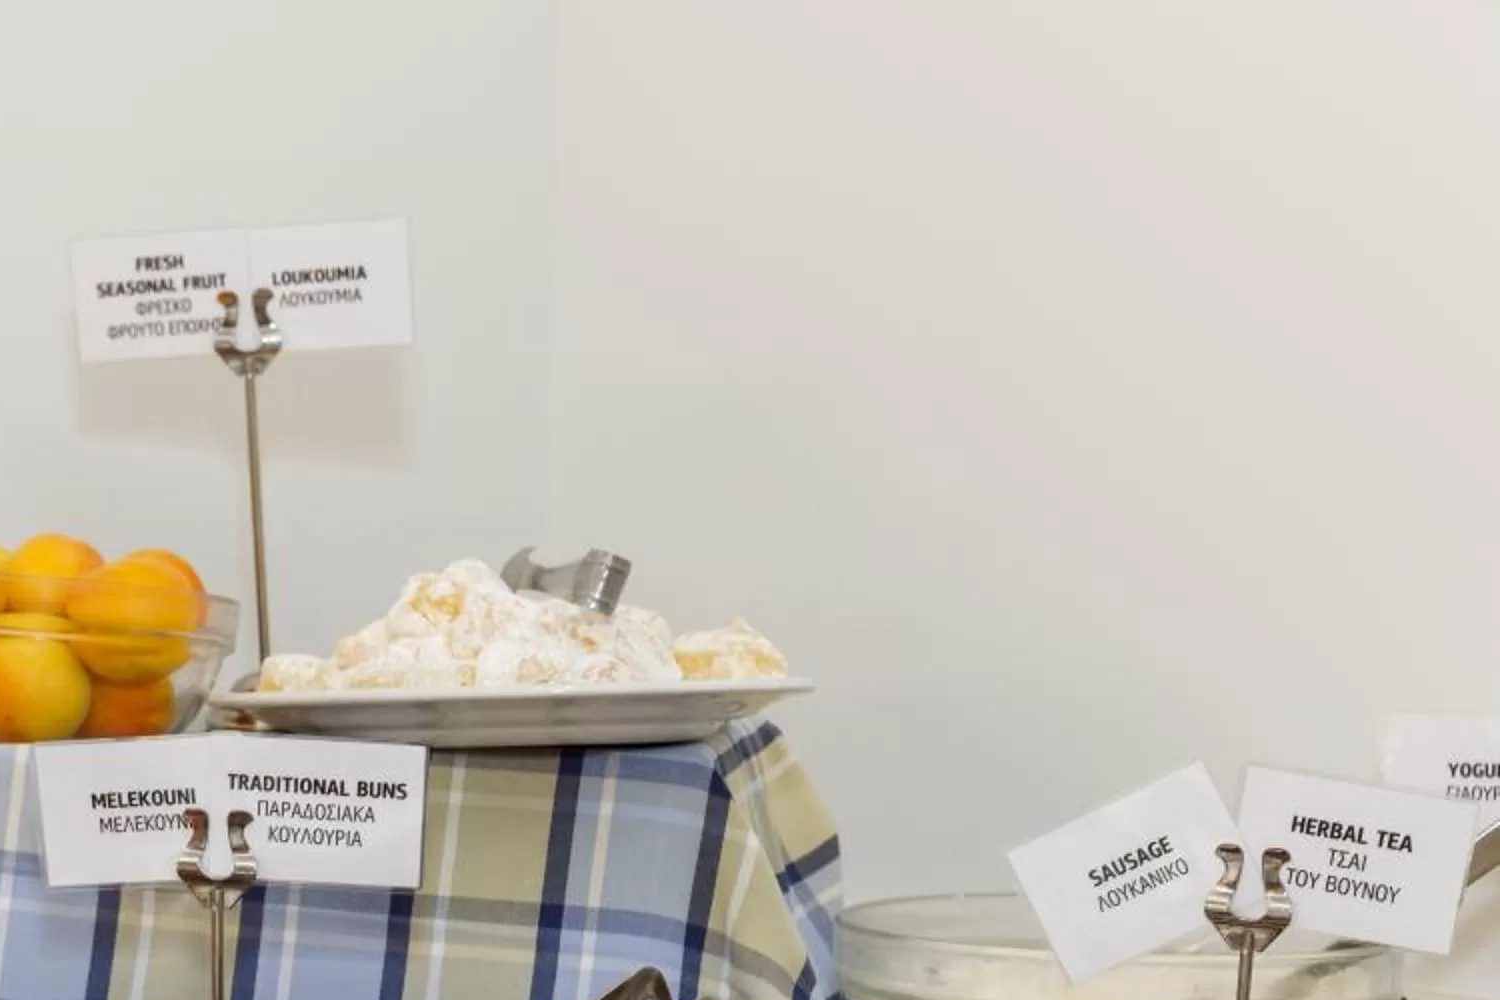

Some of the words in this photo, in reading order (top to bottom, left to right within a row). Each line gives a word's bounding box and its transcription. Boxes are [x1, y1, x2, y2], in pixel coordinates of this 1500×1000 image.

[135, 255, 185, 271] FRESH
[96, 278, 177, 298] SEASONAL
[182, 272, 226, 290] FRUIT
[271, 265, 368, 287] LOUKOUMIA
[1448, 762, 1500, 779] YOGU
[90, 787, 197, 811] MELEKOUNI
[227, 773, 350, 797] TRADITIONAL
[356, 780, 408, 801] BUNS
[98, 812, 194, 834] ΜΕΛΕΚΟΥΝ
[256, 799, 376, 823] ΠΑΡΑΔΟΣΙΑΚΑ
[267, 825, 363, 848] ΚΟΥΛΟΥΡΙΑ
[1291, 815, 1368, 845] HERBAL
[1377, 829, 1413, 853] TEA
[1087, 835, 1176, 889] SAUSAGE
[1329, 847, 1368, 872] ΤΣΑΙ
[1095, 858, 1189, 913] ΛΟΥΚΑΝΙΚΟ
[1283, 867, 1321, 892] ΤΟΥ
[1324, 874, 1401, 904] ΒΟΥΝΟΥ
